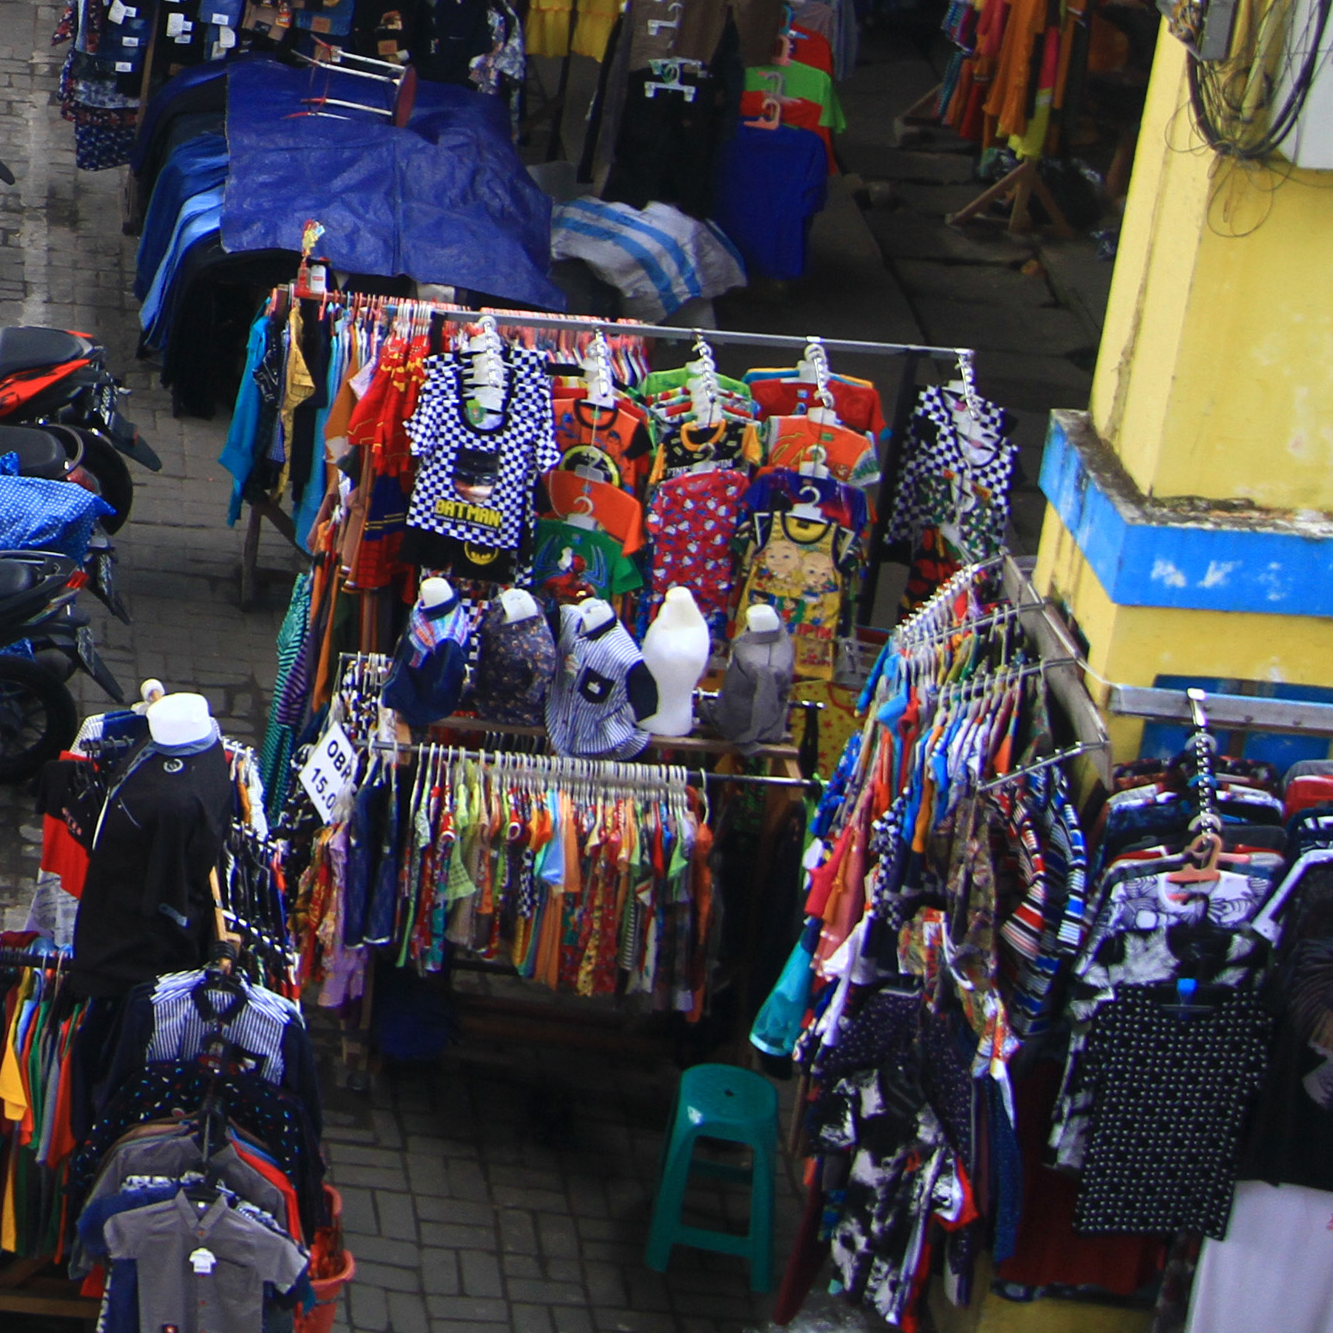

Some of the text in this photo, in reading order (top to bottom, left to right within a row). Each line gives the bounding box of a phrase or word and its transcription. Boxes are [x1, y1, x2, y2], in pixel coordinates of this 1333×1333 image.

[435, 498, 501, 527] BATMAN
[327, 740, 352, 778] OBR
[311, 768, 337, 810] 15.0
